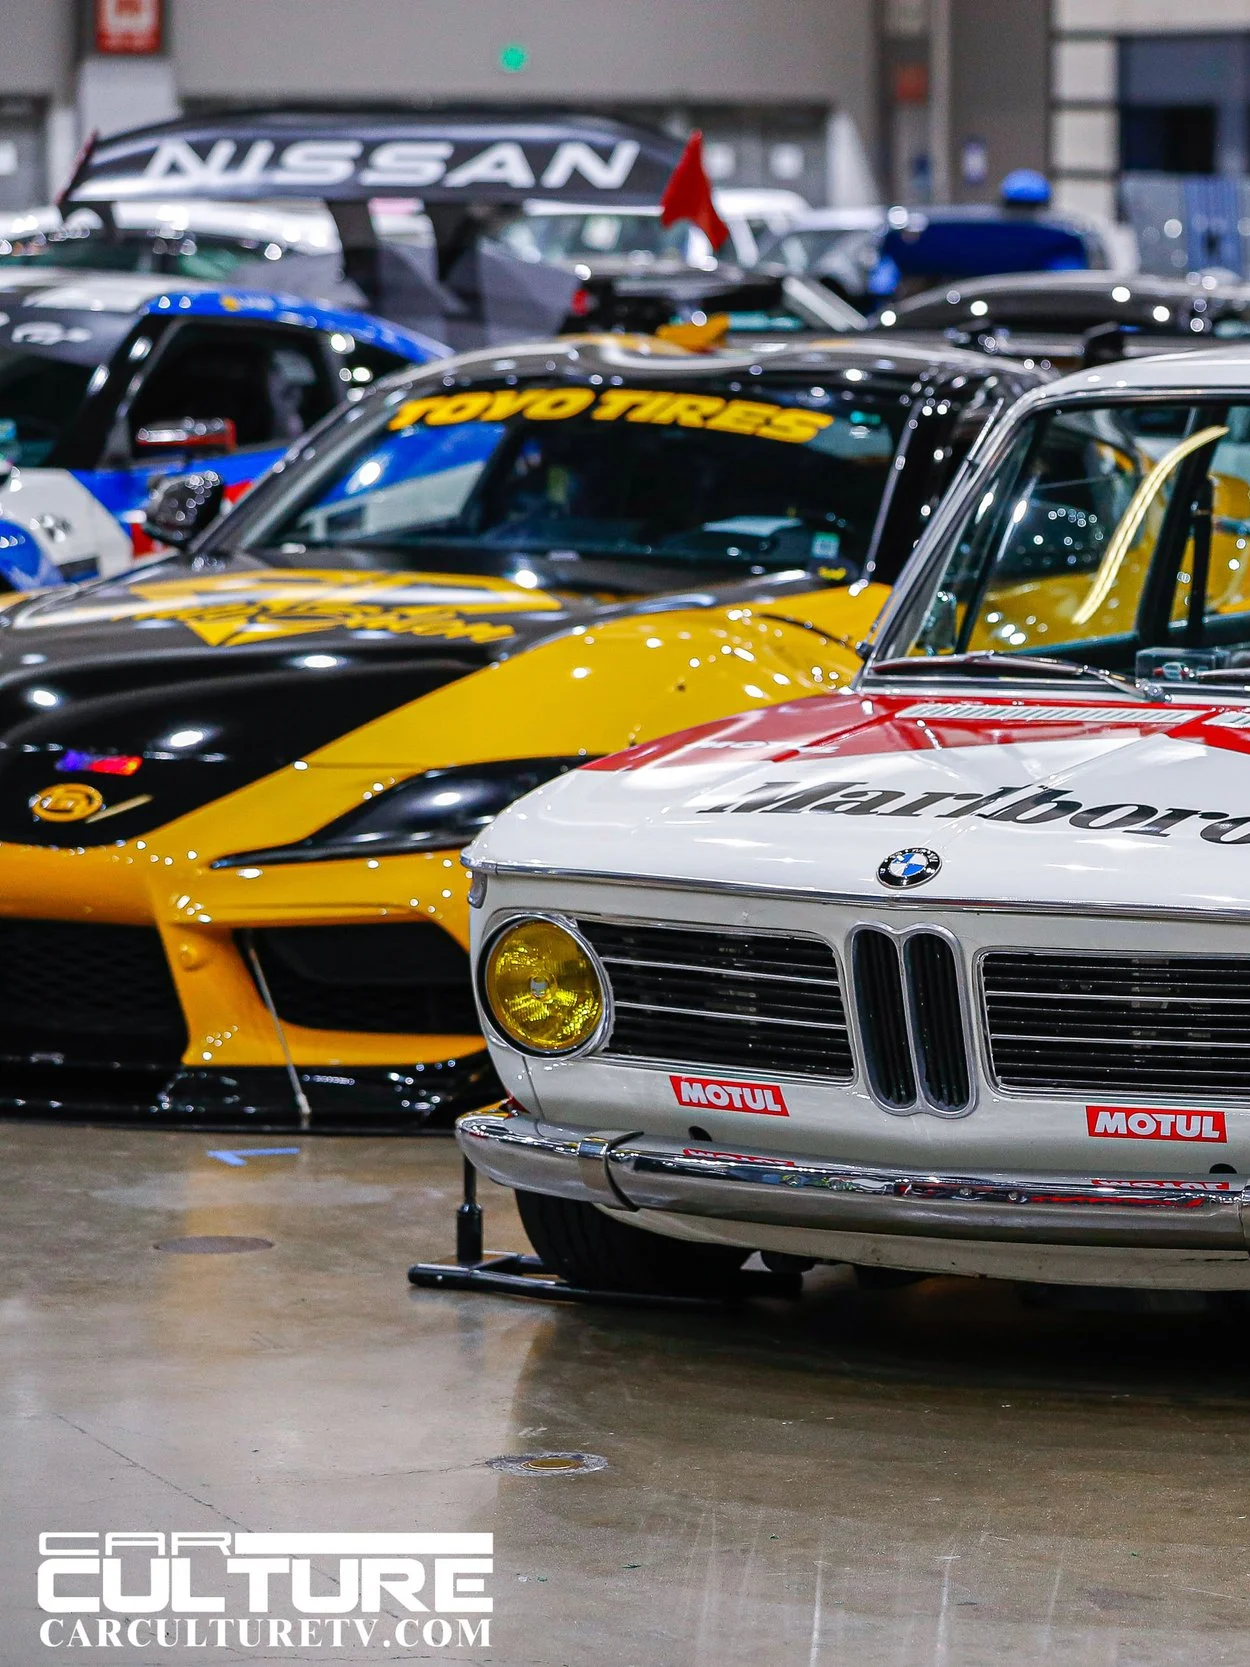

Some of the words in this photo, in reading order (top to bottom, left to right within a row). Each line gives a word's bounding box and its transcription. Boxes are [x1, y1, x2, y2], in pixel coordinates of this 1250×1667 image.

[145, 139, 640, 188] NISSAN
[388, 389, 597, 430] TOYO
[592, 389, 834, 443] TIRES
[699, 740, 840, 755] MOL
[680, 1079, 783, 1113] MOTUL
[1093, 1111, 1222, 1141] MOTUL
